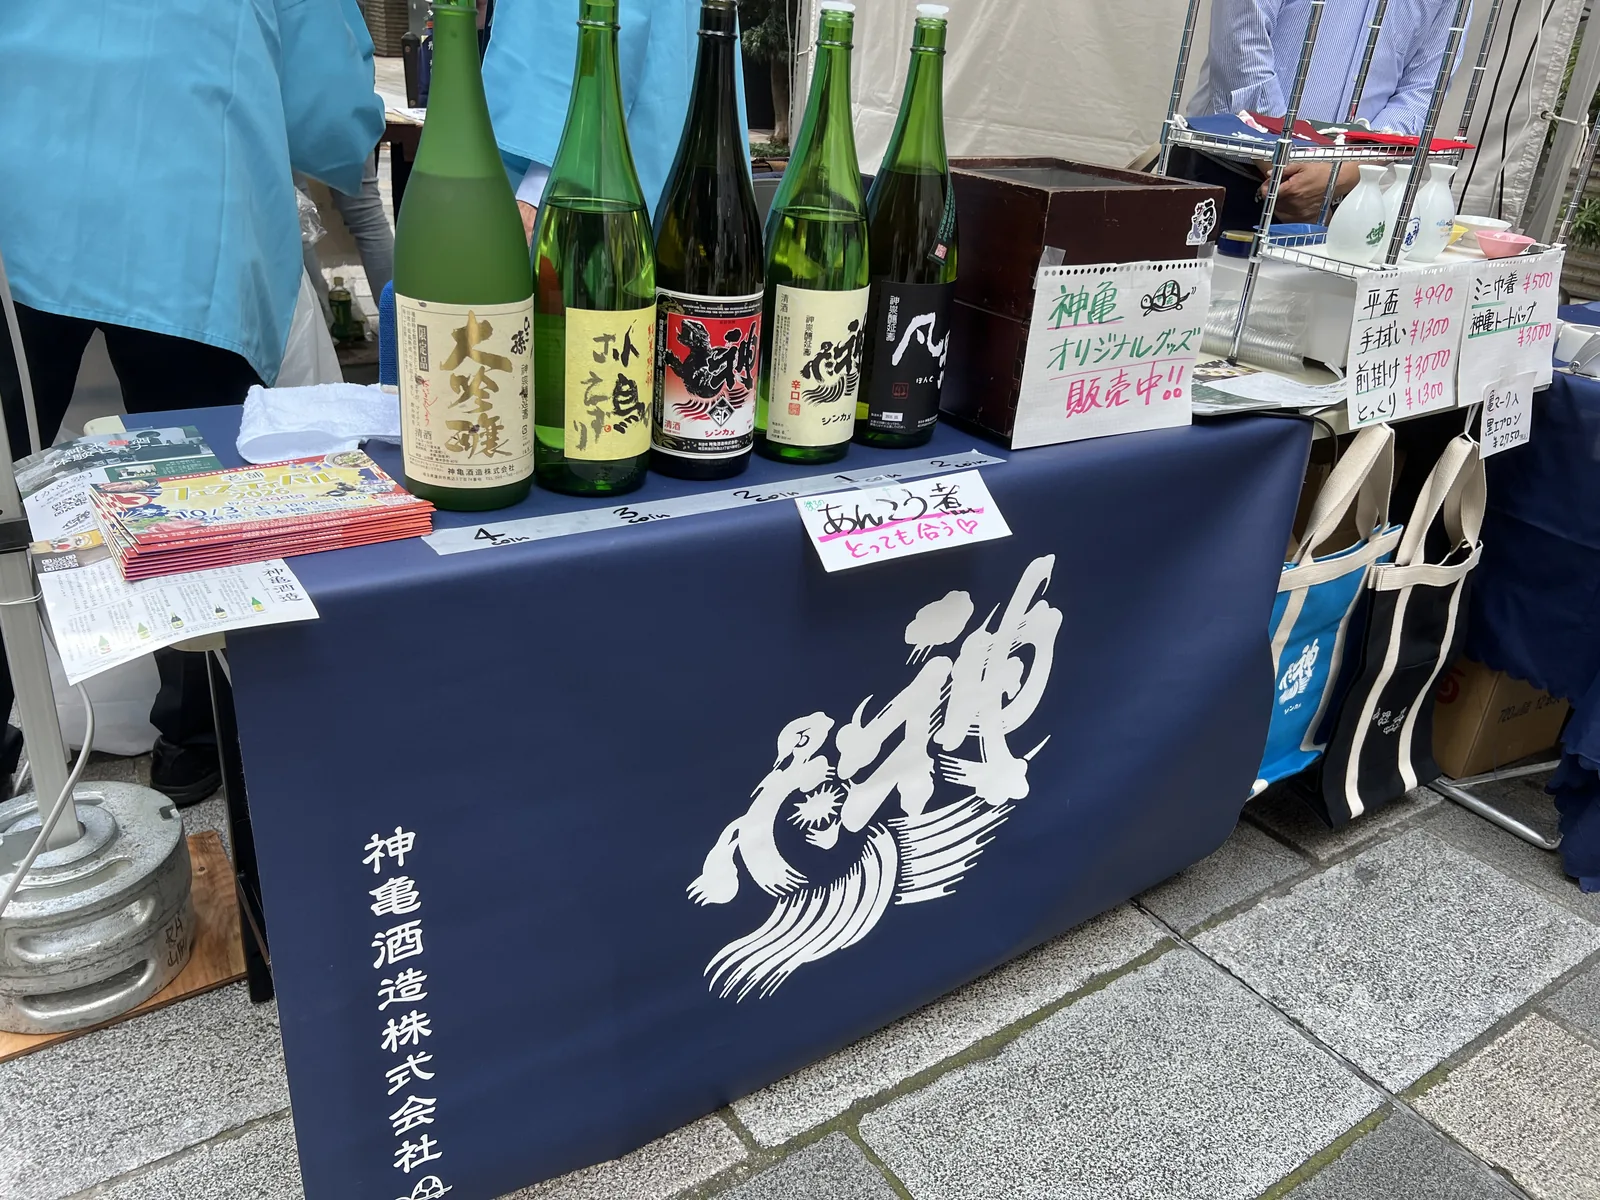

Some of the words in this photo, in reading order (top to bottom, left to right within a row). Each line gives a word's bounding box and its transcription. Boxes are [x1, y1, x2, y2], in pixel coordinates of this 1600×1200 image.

[1362, 288, 1400, 320] 平盃
[1413, 283, 1453, 309] ¥990
[1473, 270, 1518, 301] ミニ巾着
[1522, 272, 1553, 294] ¥500
[1048, 281, 1124, 329] 神亀
[1047, 327, 1201, 371] オリジナルグッズ
[1360, 320, 1406, 354] 手拭い
[1410, 317, 1449, 345] ¥1,300
[1517, 322, 1552, 347] ¥3,000
[1356, 357, 1400, 392] 前掛け
[1404, 349, 1450, 383] ¥3,000
[790, 380, 801, 401] 辛口
[1066, 361, 1183, 418] 販売中!!
[1357, 392, 1397, 421] とっくり
[1405, 381, 1443, 410] ¥1,300
[705, 428, 735, 438] シンカメ
[448, 464, 515, 476] 神亀酒造株式会社
[930, 460, 951, 468] 2
[613, 506, 639, 519] 3
[733, 490, 761, 500] 2
[817, 482, 979, 535] あんこう煮
[474, 527, 506, 541] 4
[845, 521, 954, 558] とっても合う
[362, 826, 443, 1174] 神亀酒造株式会社
